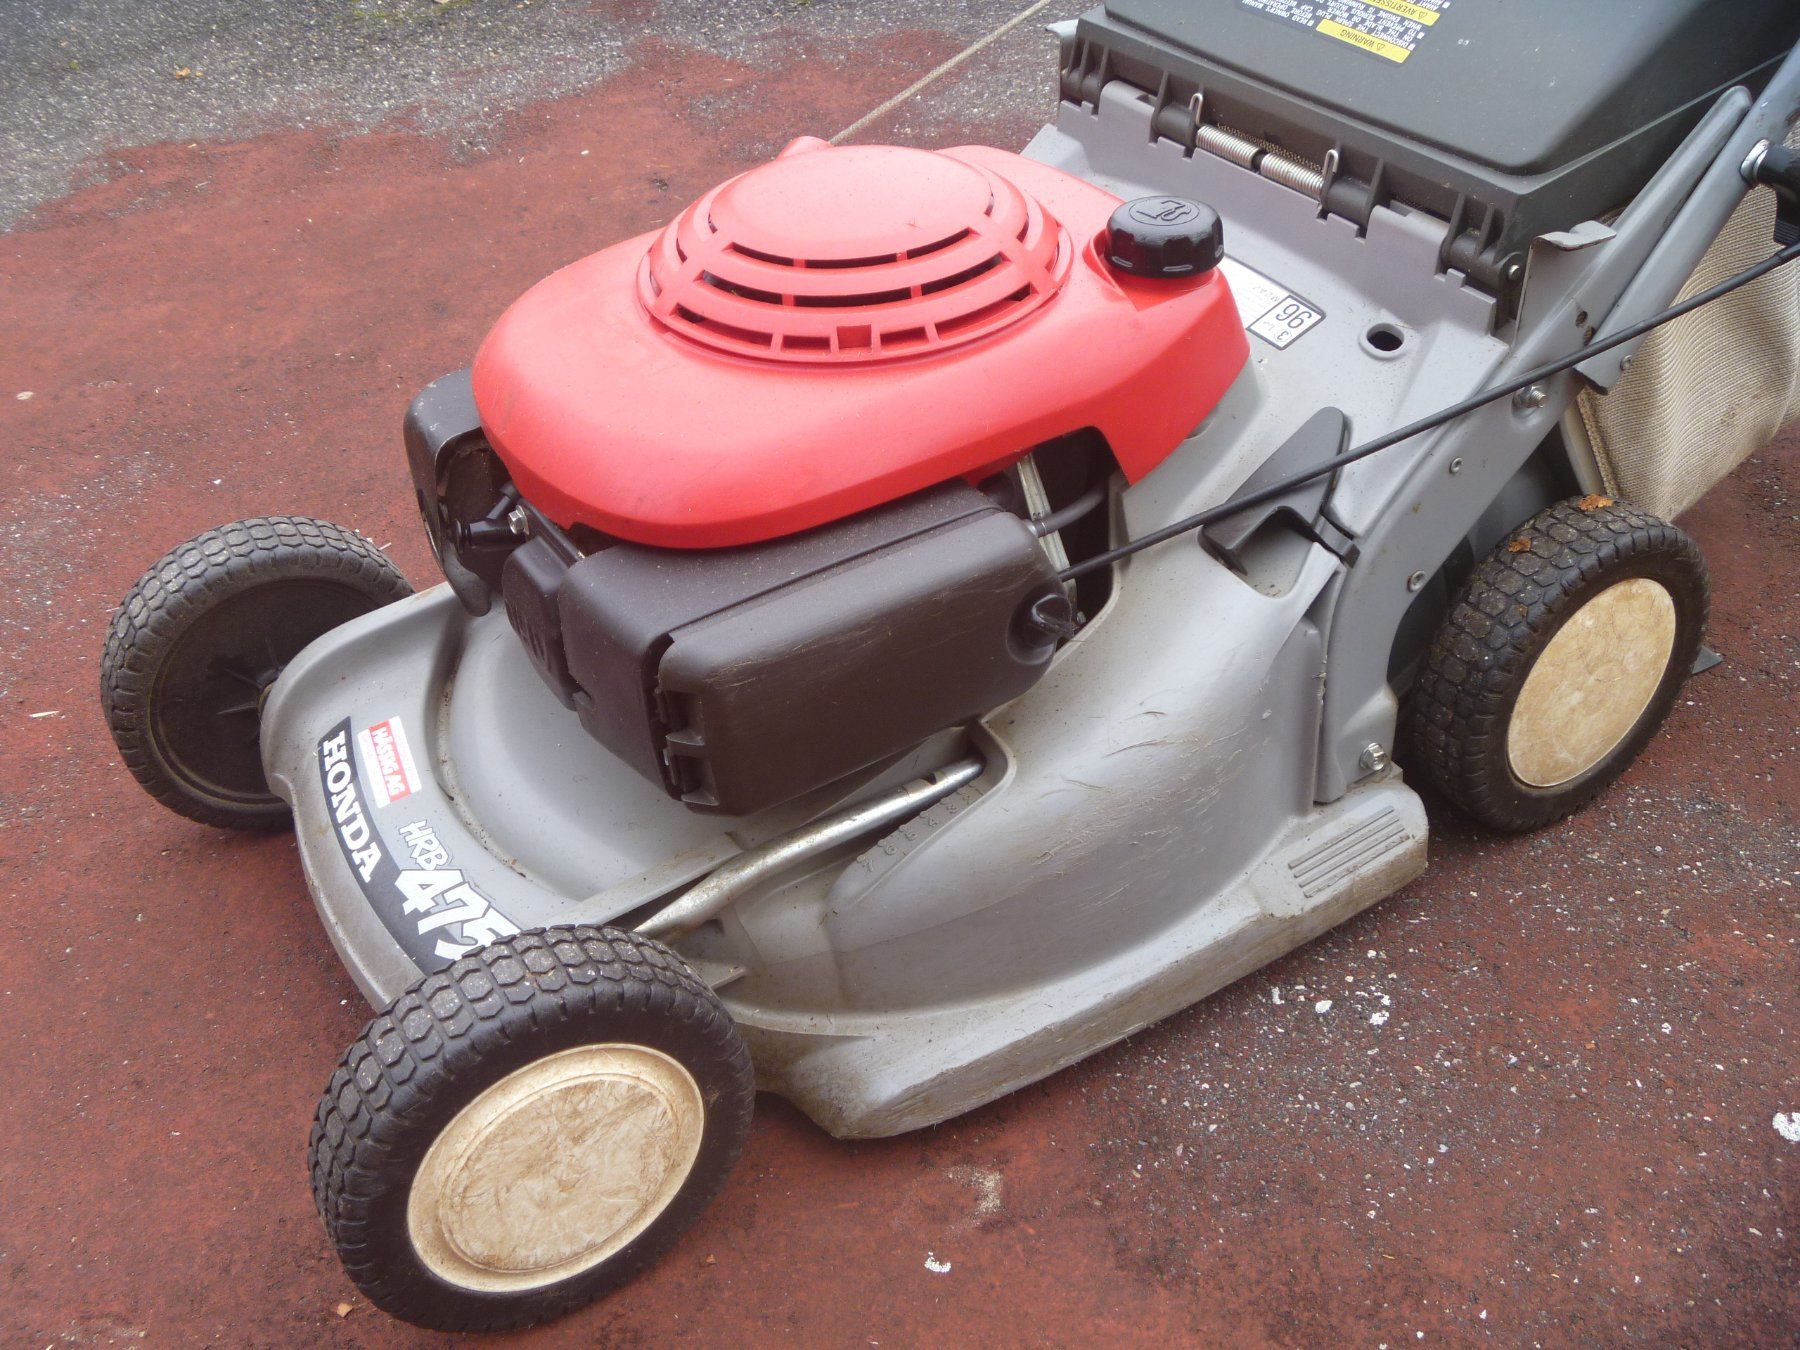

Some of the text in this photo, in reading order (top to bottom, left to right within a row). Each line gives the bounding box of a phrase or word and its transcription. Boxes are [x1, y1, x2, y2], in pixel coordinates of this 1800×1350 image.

[1340, 29, 1375, 49] WARNING
[1275, 303, 1312, 329] 96
[323, 730, 384, 884] HONDA
[399, 819, 452, 870] HRB
[394, 869, 522, 961] 475
